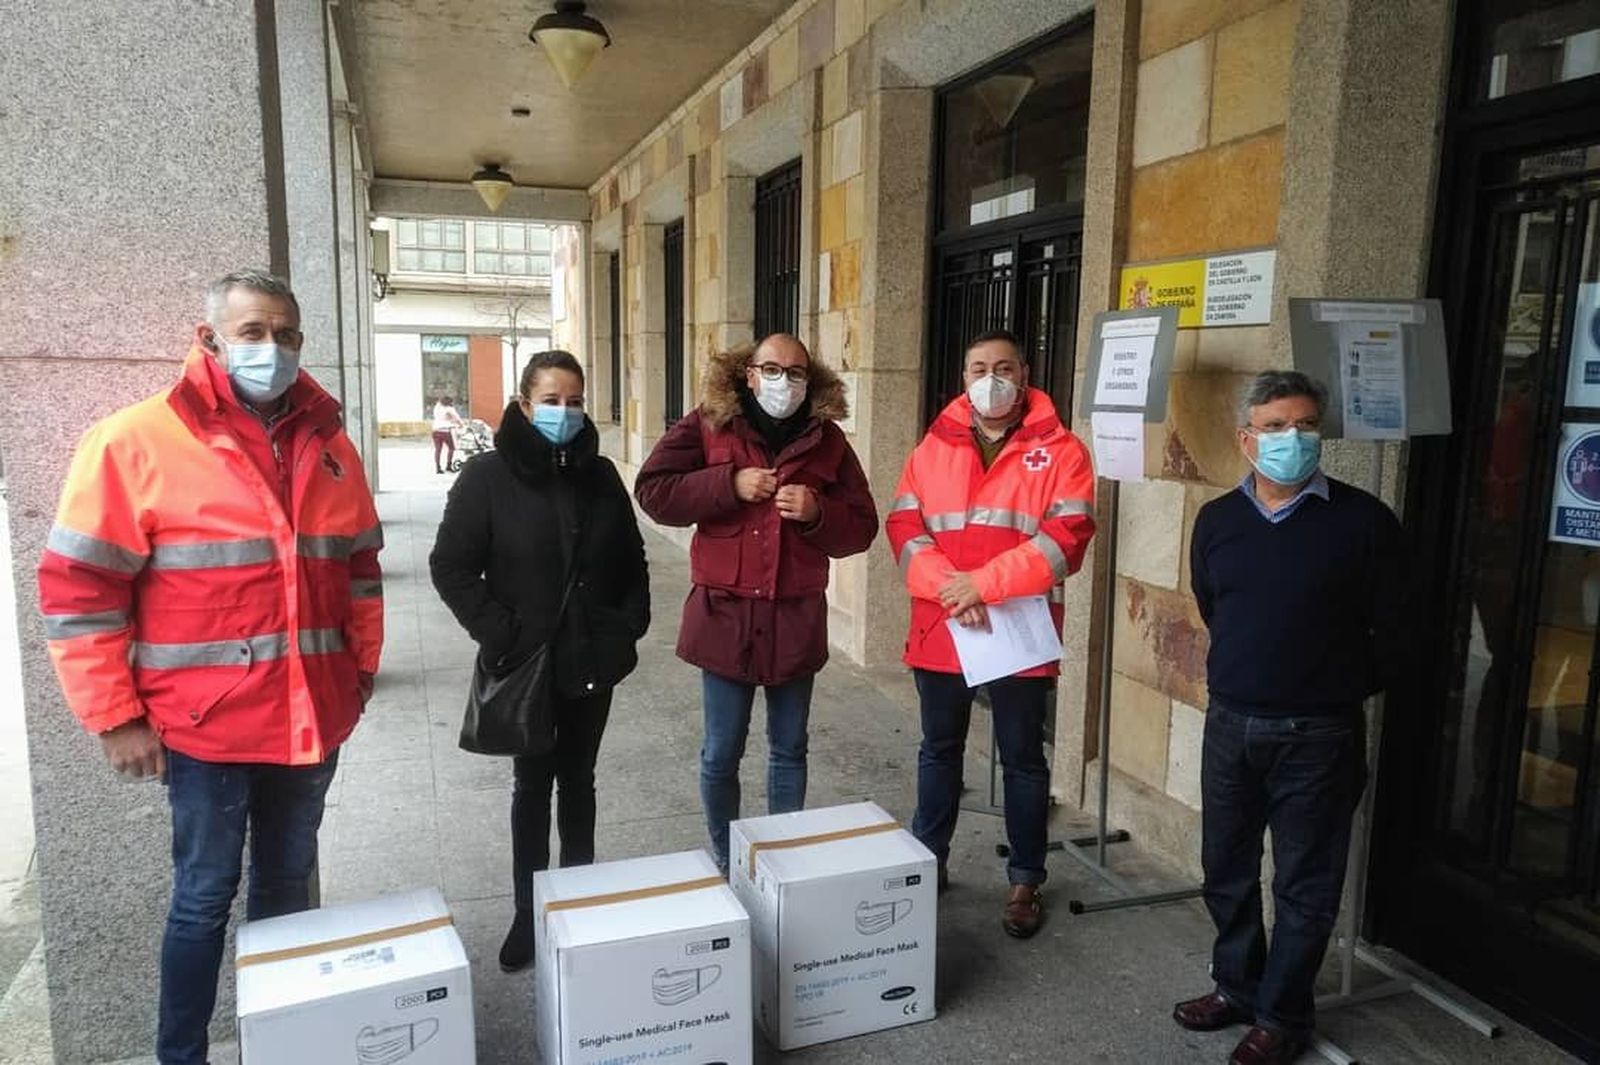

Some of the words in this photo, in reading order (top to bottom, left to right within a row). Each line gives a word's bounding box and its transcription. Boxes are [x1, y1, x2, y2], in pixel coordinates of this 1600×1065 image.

[1220, 267, 1247, 276] GOBIERNO
[1216, 277, 1241, 285] CASTILLA
[1157, 286, 1196, 298] GOBIERNO
[1218, 302, 1246, 311] GOBIERNO
[793, 957, 838, 973] Single-use
[840, 948, 874, 962] Medical
[876, 946, 895, 956] Face
[897, 940, 919, 951] Mask
[400, 993, 425, 1007] 2000
[430, 989, 445, 1000] PCS
[903, 1001, 918, 1015] CE
[578, 1031, 634, 1049] Single-use
[636, 1021, 677, 1037] Medical
[679, 1019, 702, 1030] Face
[705, 1011, 730, 1025] Mask
